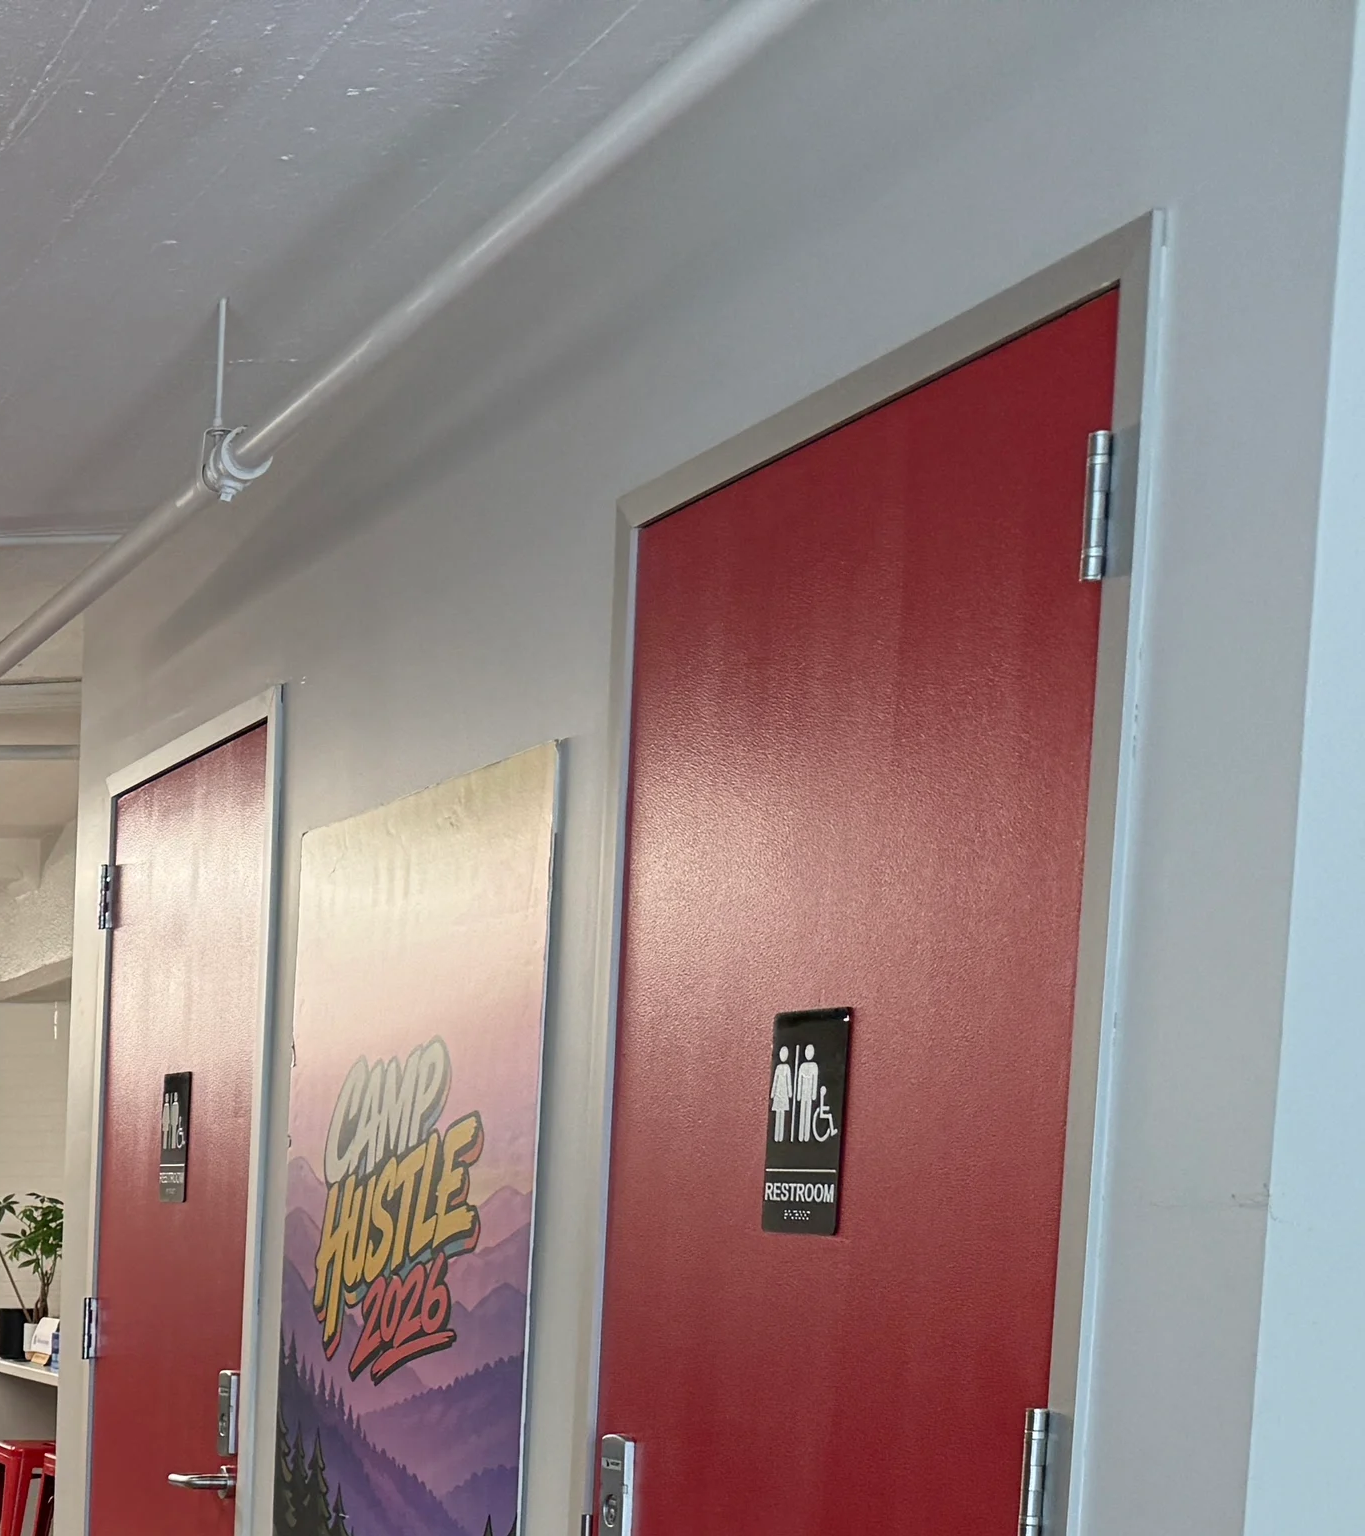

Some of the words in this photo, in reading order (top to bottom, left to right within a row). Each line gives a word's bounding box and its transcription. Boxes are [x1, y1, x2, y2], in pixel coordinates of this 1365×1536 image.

[327, 1036, 450, 1184] CAMP
[314, 1111, 482, 1358] HUSTLE
[765, 1182, 835, 1203] RESTROOM
[350, 1254, 450, 1380] 2026
